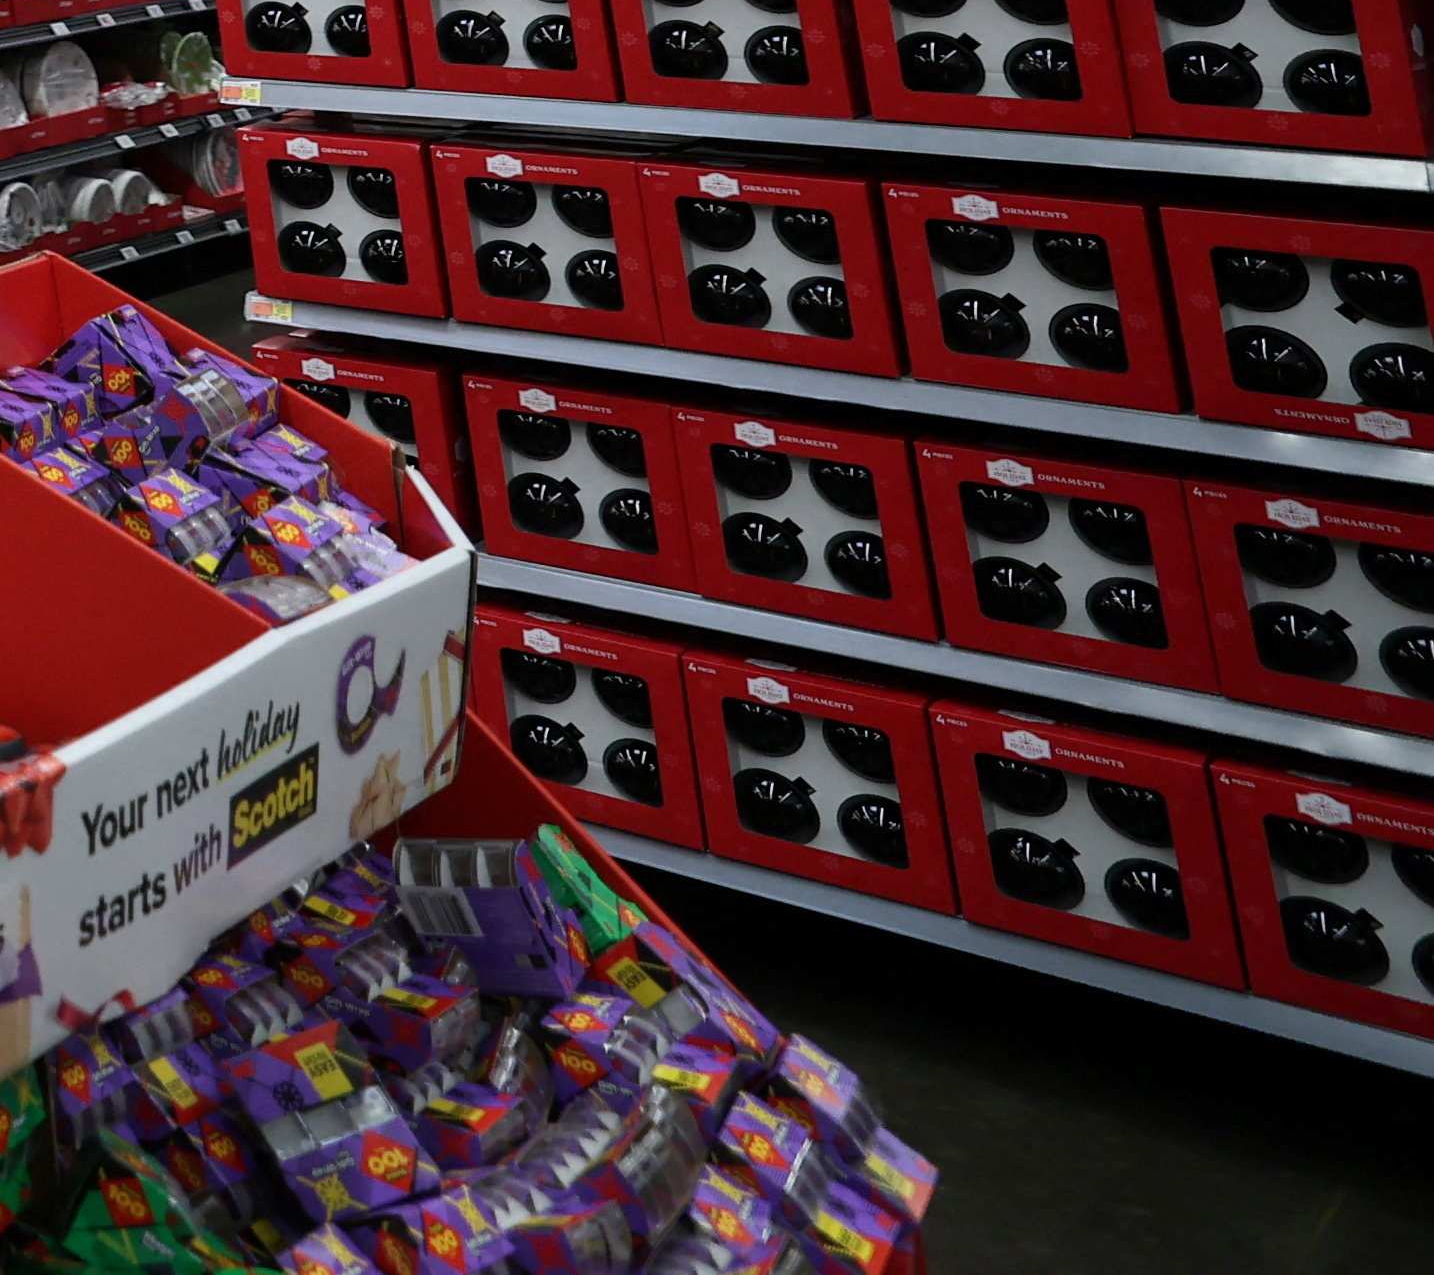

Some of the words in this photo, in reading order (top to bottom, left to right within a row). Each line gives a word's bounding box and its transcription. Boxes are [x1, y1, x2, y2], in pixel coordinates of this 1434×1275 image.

[1001, 206, 1069, 220] ORNAMENTS
[1323, 514, 1402, 535] ORNAMENTS
[792, 692, 855, 712] ORNAMENTS
[1054, 747, 1126, 770] ORNAMENTS
[80, 793, 149, 857] Your
[155, 746, 210, 820] next
[215, 699, 301, 782] holiday
[78, 872, 168, 949] starts
[173, 823, 222, 896] with
[232, 763, 316, 850] Scotch
